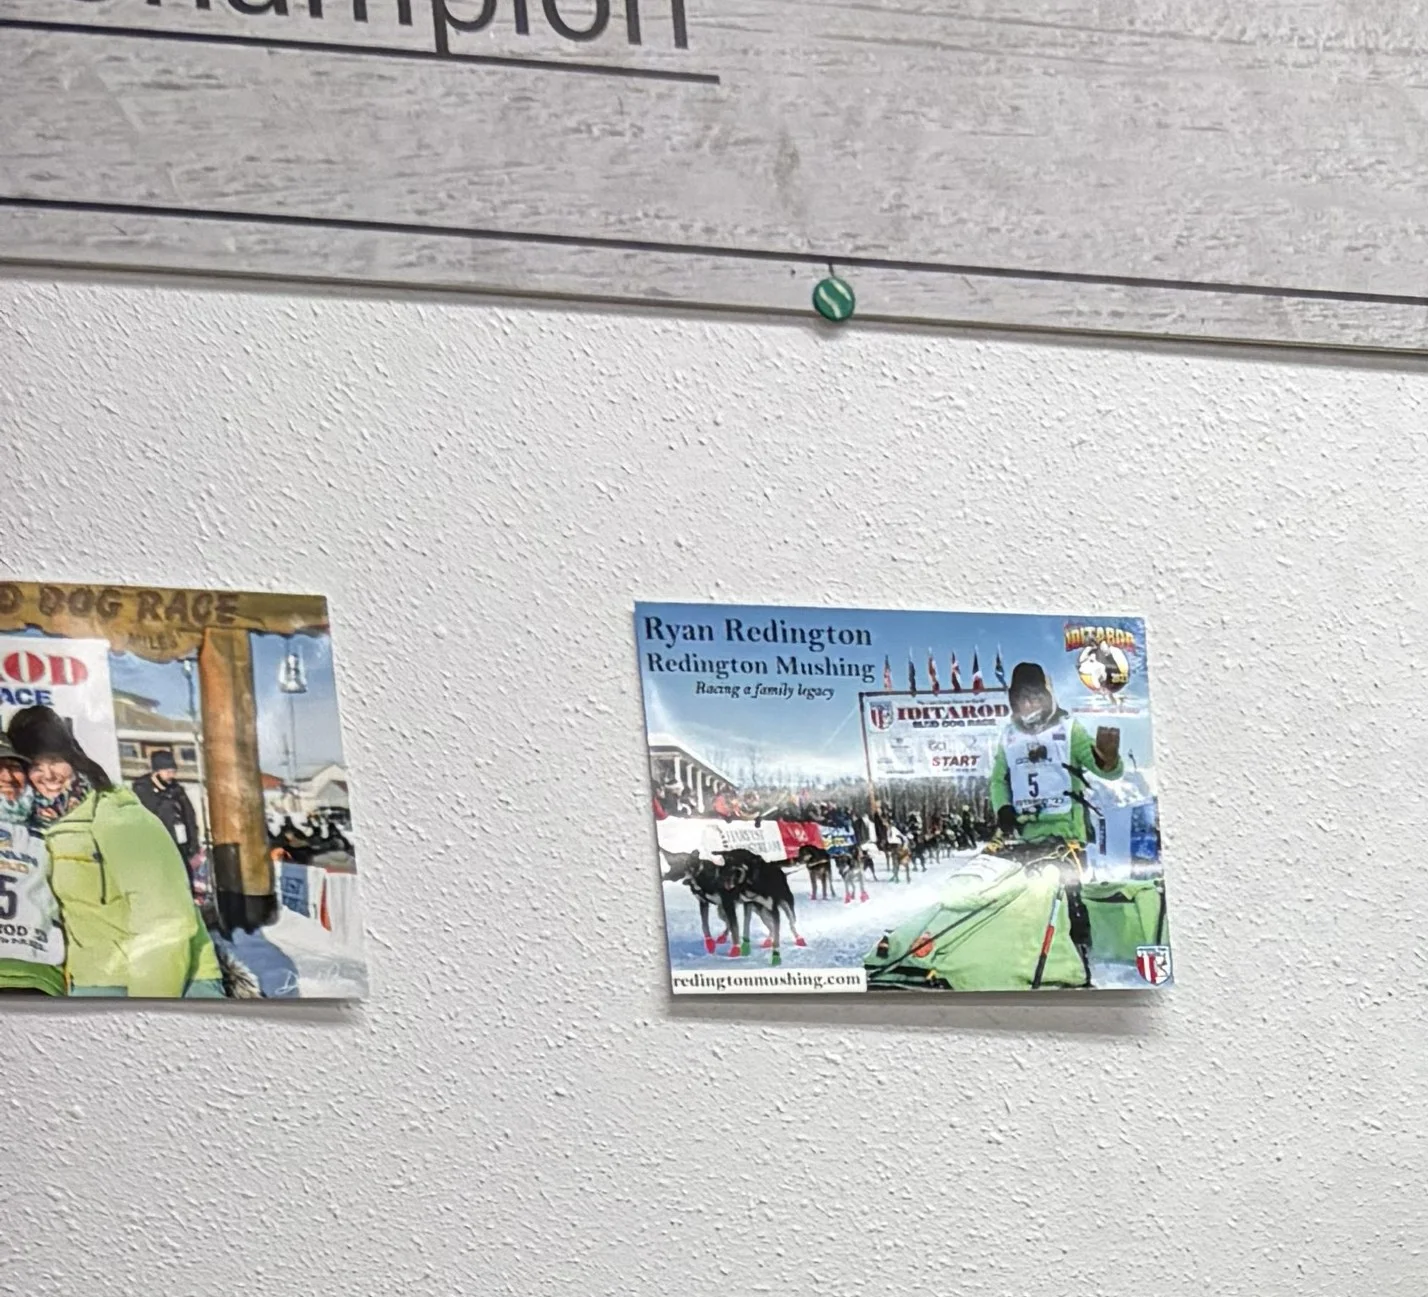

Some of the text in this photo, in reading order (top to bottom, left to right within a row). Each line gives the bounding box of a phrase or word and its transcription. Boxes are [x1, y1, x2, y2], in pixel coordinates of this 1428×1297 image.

[38, 586, 123, 619] DOG
[136, 589, 240, 626] RACE
[644, 616, 873, 653] Ryan Redington
[0, 650, 88, 686] OD
[647, 653, 876, 684] Redington Mushing
[0, 687, 54, 706] ACE
[696, 681, 740, 698] Racing
[750, 683, 795, 700] family
[797, 683, 836, 701] legacy
[896, 704, 1010, 722] IDITAROD
[932, 755, 981, 768] START
[1028, 773, 1039, 798] 5
[673, 972, 862, 992] redingtonmushing.com
